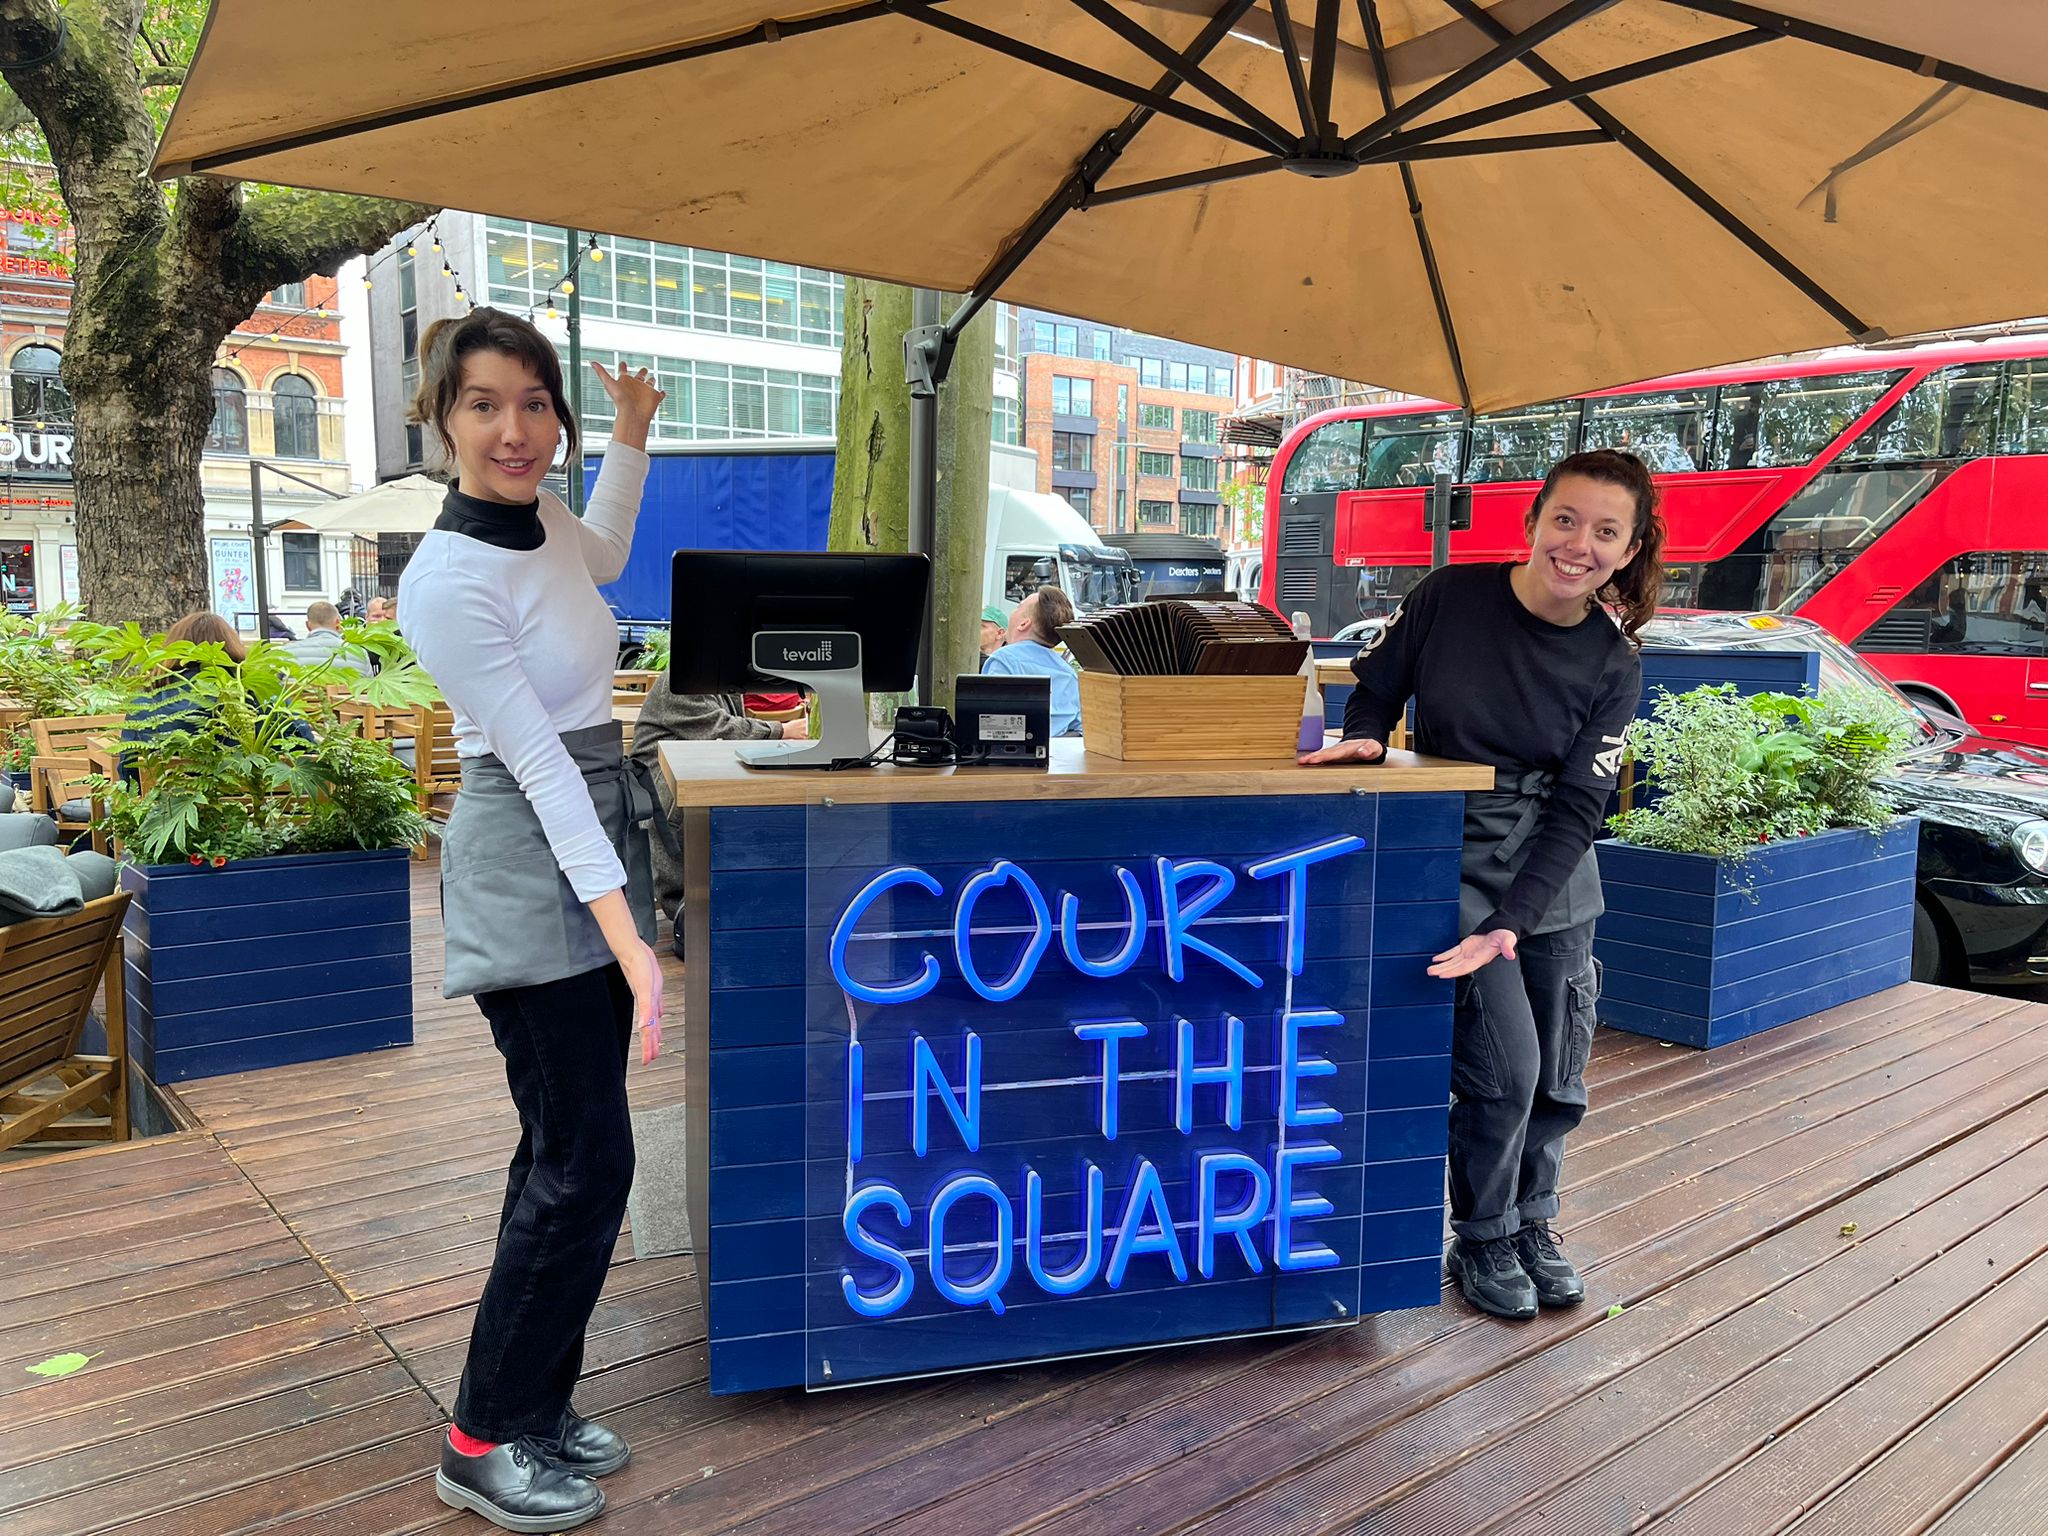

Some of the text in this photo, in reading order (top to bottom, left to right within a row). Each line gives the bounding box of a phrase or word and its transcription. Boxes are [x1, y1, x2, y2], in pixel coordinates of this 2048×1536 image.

[0, 432, 74, 465] OUR
[214, 550, 249, 558] GUNTER
[1168, 566, 1199, 577] Dexters
[782, 644, 832, 661] tevalis
[830, 834, 1367, 1005] COURT
[848, 1009, 1346, 1164] IN THE
[841, 1142, 1344, 1317] SQUARE
